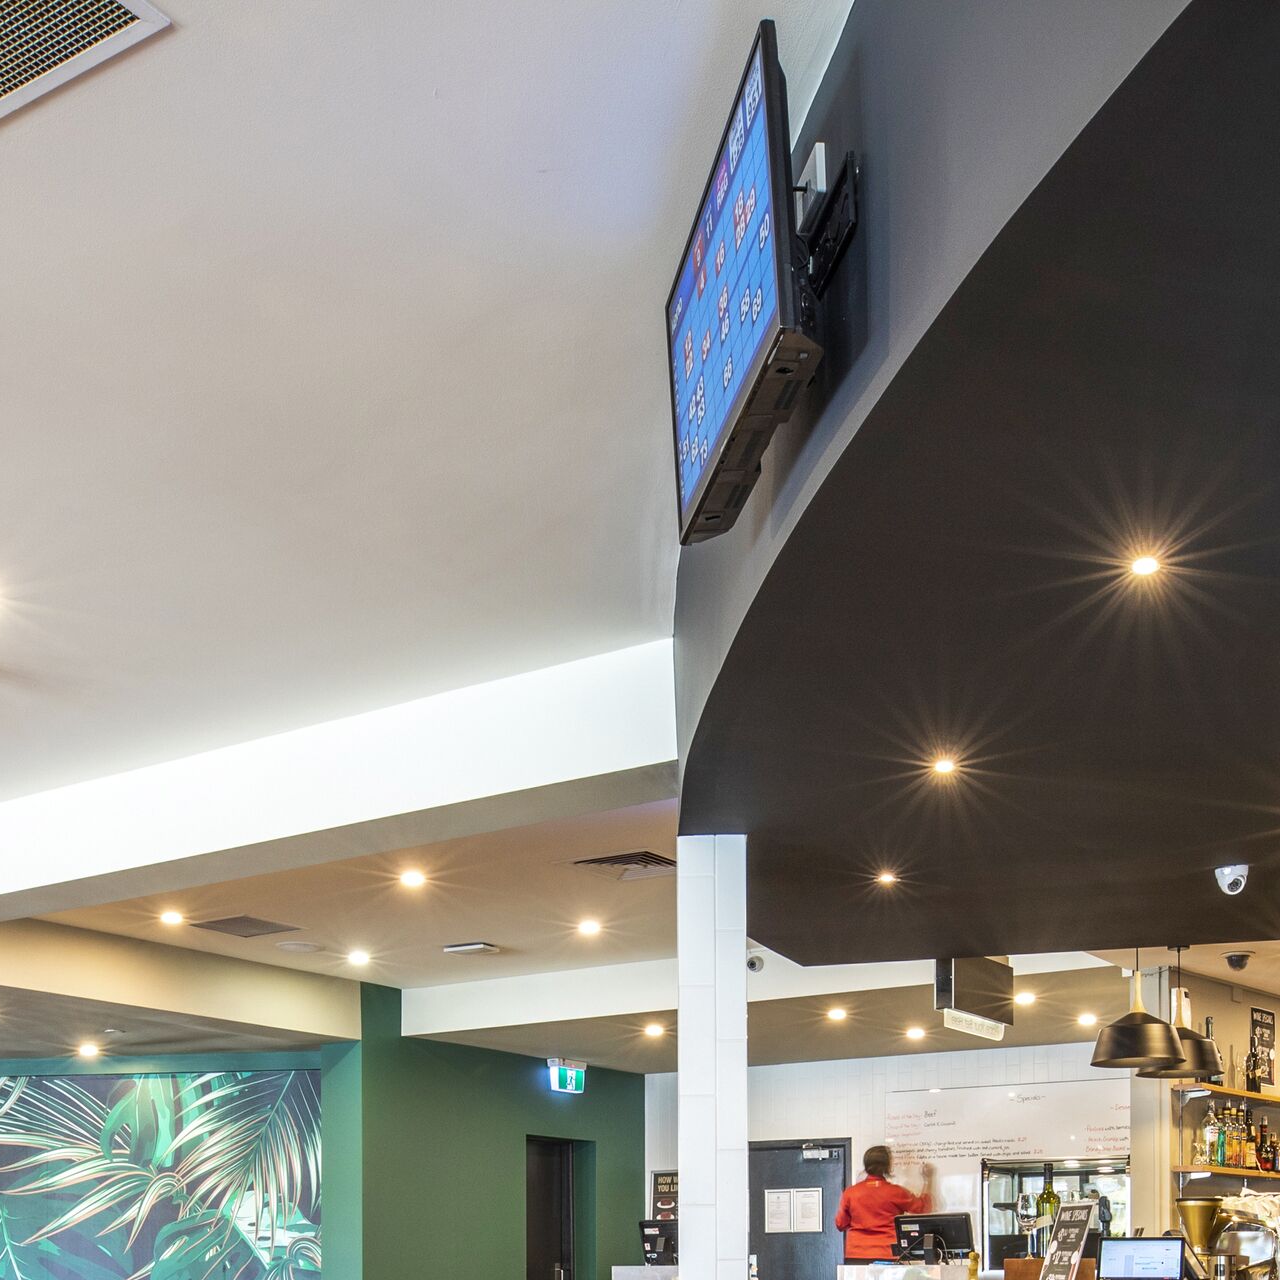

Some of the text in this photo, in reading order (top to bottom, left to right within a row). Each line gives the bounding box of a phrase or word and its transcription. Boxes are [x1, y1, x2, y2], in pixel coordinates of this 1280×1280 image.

[734, 188, 743, 225] 18
[735, 187, 755, 250] 28 29
[759, 210, 769, 250] 50
[740, 287, 749, 323] 58
[723, 356, 732, 388] 66
[751, 287, 761, 323] 69
[657, 1176, 673, 1184] HOW
[657, 1184, 670, 1192] YOU
